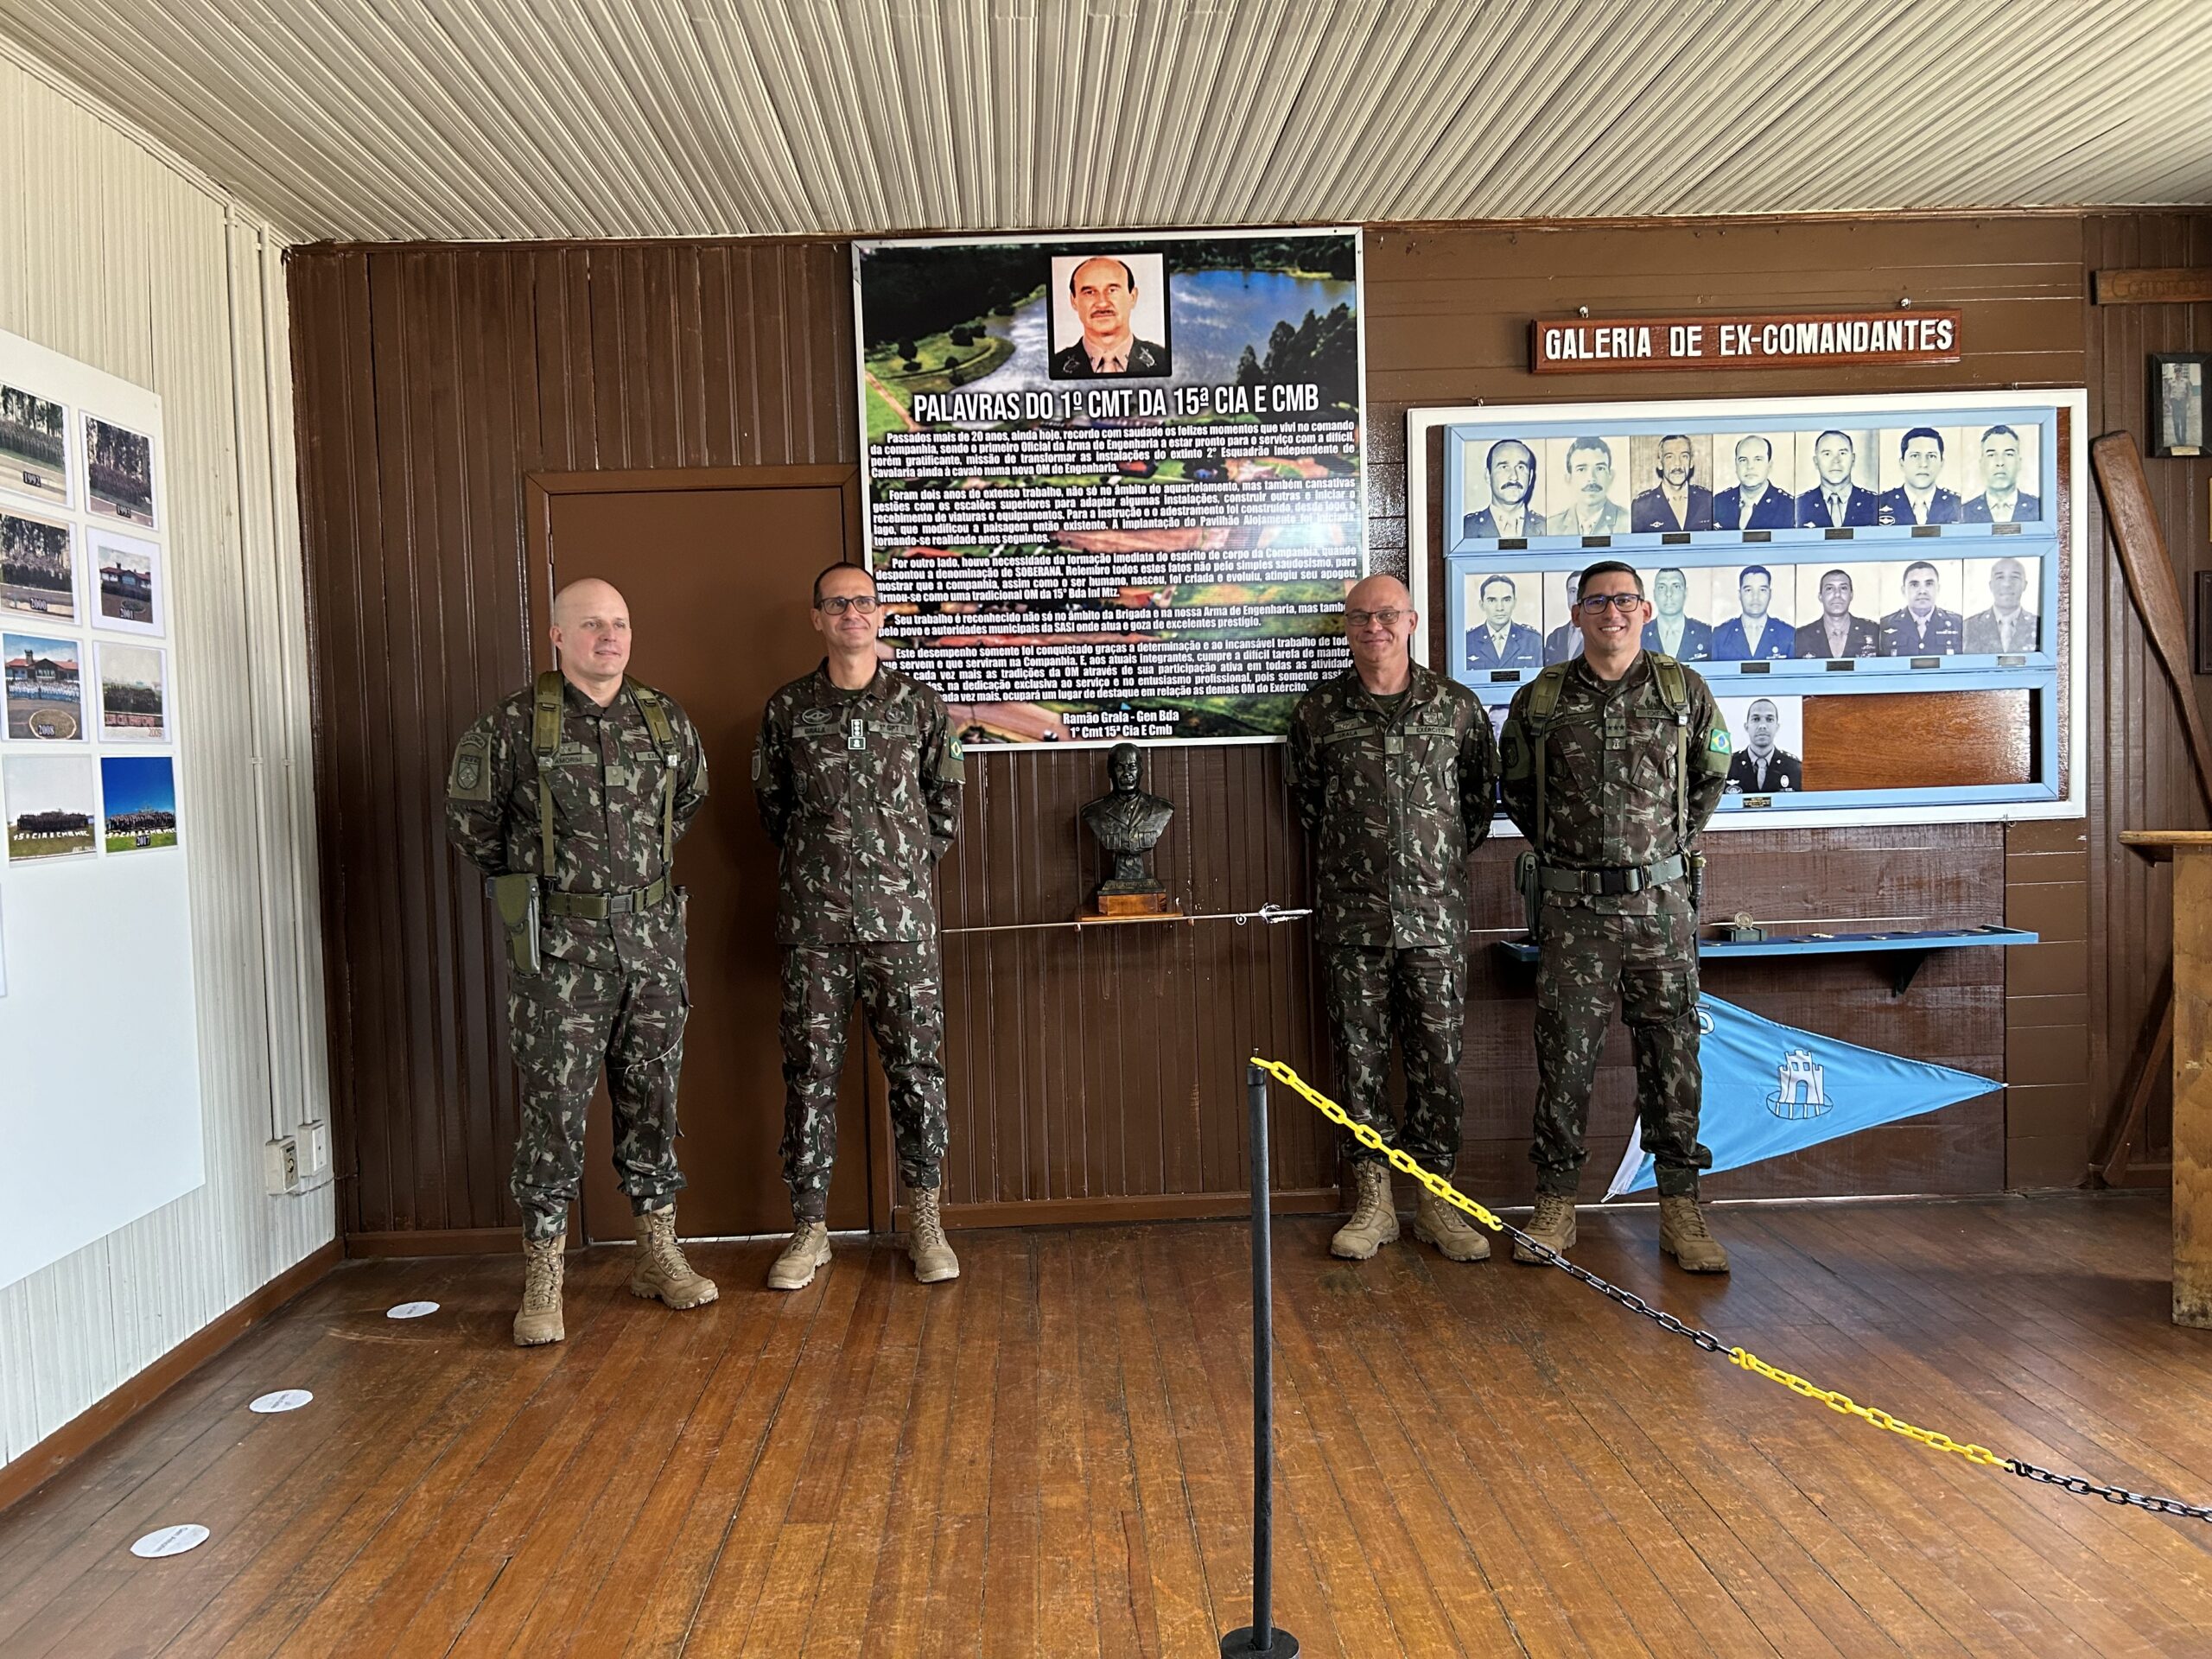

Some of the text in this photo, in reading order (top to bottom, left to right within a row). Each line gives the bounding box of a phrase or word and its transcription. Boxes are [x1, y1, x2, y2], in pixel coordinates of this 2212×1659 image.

[1545, 319, 1953, 359] GALERIA DE EX-COMANDANTES
[913, 391, 1020, 422] PALAVRAS
[1026, 391, 1053, 420] DO
[1088, 390, 1132, 418] CMT
[1138, 389, 1166, 417] DA
[1173, 388, 1209, 416] 15ª
[1214, 386, 1249, 414] CIA
[1255, 386, 1267, 413] E
[1272, 384, 1319, 412] CMB
[887, 421, 1354, 444] Passados 20 recordo saudade felizes momentos comando
[885, 432, 1355, 458] companhia, primeiro Oficial Engenharia pronto serviço difícil,
[906, 444, 1338, 468] gratificante, missão transformar instalações extinto Esquadrão Independente
[23, 472, 41, 486] 1992
[871, 461, 1119, 479] Cavalaria cavalo Engenharia.
[983, 479, 1302, 499] extenso trabalho, âmbito aquartelamento, também
[873, 493, 1219, 515] gestões escalões superiores adaptar algumas instalações,
[874, 504, 1224, 524] recebimento viaturas equipamentos. instrução adestramento
[922, 515, 1239, 535] modificou paisagem existente. implantação Pavilhão
[874, 532, 1050, 547] tornando-se realidade seguintes.
[992, 550, 1206, 566] necessidade formação imediata espírito
[876, 559, 1273, 582] despontou denominação SOBERANA. Relembro simples
[877, 570, 1357, 592] mostrar companhia, humano, nasceu, criada evoluiu, apogeu,
[30, 598, 47, 610] 2000
[972, 589, 1022, 601] tradicional
[119, 608, 134, 620] 2001
[914, 604, 1296, 625] trabalho reconhecido âmbito Brigada Engenharia,
[931, 616, 1261, 636] autoridades municipais SASI excelentes prestígio.
[900, 647, 1350, 670] servem serviram Companhia. atuais integrantes, cumpre difícil tarefa manter
[918, 637, 1316, 660] desempenho somente conquistado graças determinação incansável trabalho
[1001, 662, 1216, 680] tradições através participação
[963, 671, 1319, 692] dedicação exclusiva serviço entusiasmo profissional, somente
[1002, 682, 1308, 702] ocupará destaque relação demais Exército.
[1063, 712, 1099, 725] Ramão
[1101, 711, 1129, 723] Grala
[1136, 710, 1157, 722] Gen
[1159, 709, 1179, 721] Bda
[38, 725, 54, 735] 2008
[1082, 726, 1103, 738] Cmt
[1104, 725, 1121, 737] 15ª
[1122, 724, 1140, 736] Cia
[1141, 724, 1147, 736] E
[1148, 723, 1173, 736] Cmb
[554, 756, 583, 765] AMORIM
[137, 836, 150, 846] 2017
